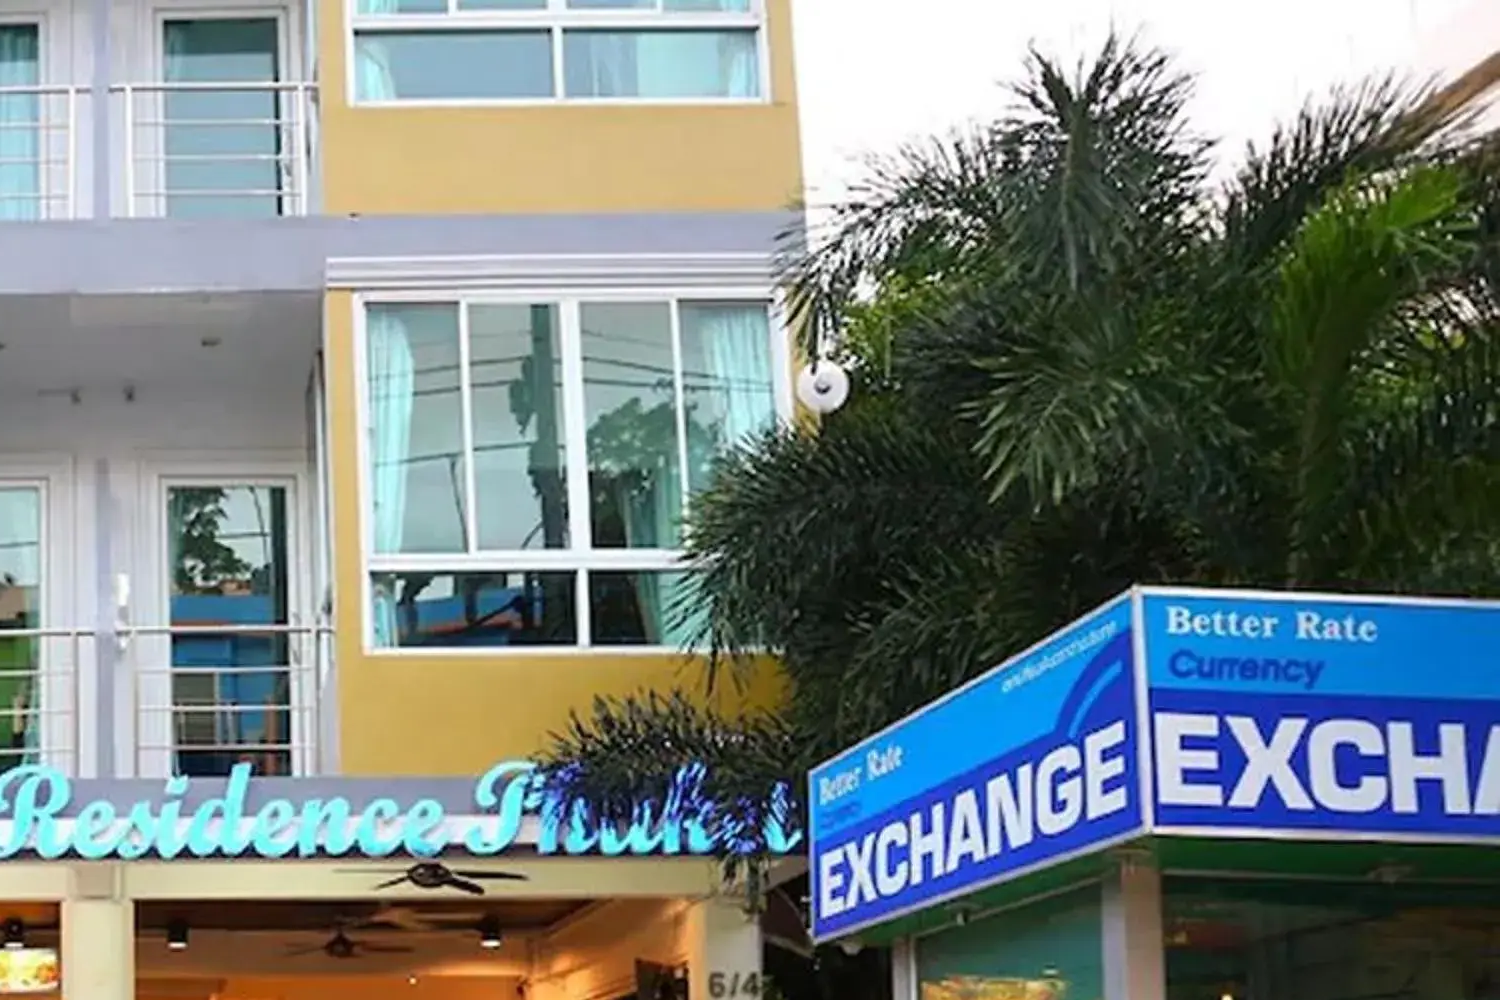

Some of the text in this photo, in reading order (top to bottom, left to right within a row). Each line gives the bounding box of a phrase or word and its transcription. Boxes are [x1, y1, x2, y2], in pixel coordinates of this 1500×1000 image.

[1165, 605, 1378, 642] Better Rate
[1168, 648, 1326, 690] Currency
[818, 721, 1127, 920] EXCHANGE
